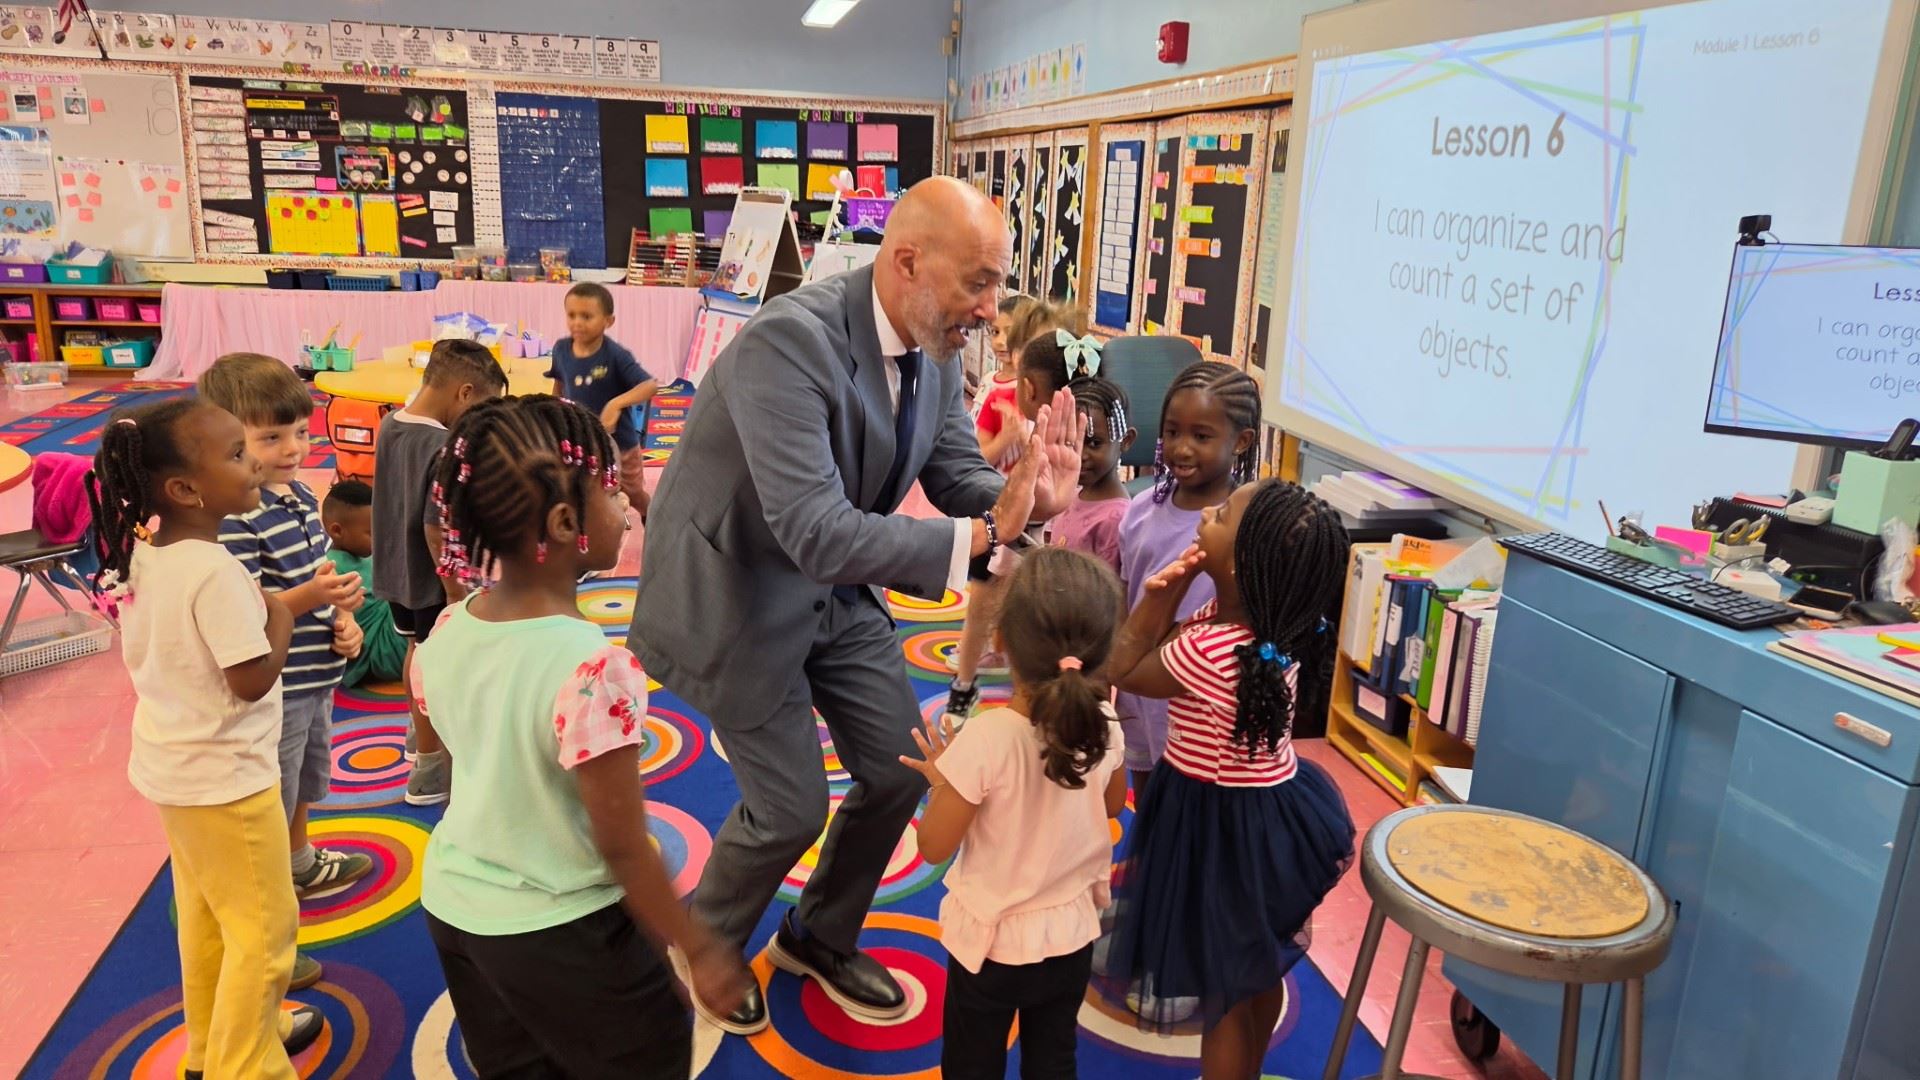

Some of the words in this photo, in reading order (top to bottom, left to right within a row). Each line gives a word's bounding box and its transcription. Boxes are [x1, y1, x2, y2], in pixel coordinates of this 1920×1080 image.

[137, 15, 149, 27] Ss
[182, 16, 195, 29] Uu
[206, 19, 221, 30] Vv
[228, 20, 248, 32] Ww
[256, 22, 269, 33] Xx
[280, 23, 294, 39] Yy
[305, 25, 318, 37] Zz
[343, 24, 352, 35] 0
[412, 28, 420, 40] 2
[446, 31, 455, 42] 3
[478, 33, 487, 45] 4
[511, 35, 519, 47] 5
[541, 37, 550, 48] 6
[573, 39, 580, 50] 7
[1692, 36, 1740, 55] Module
[1753, 31, 1804, 50] Lesson
[1808, 27, 1820, 46] 6
[607, 41, 615, 52] 8
[639, 43, 648, 54] 9
[343, 61, 417, 78] Calendar
[665, 102, 741, 117] WRITER'S
[799, 109, 864, 122] CORNER
[1431, 117, 1530, 158] Lesson
[1546, 113, 1565, 158] 6
[1374, 199, 1380, 232] I
[1387, 206, 1424, 239] can
[1433, 210, 1548, 261] organize
[1561, 214, 1628, 263] and
[1390, 262, 1454, 299] count
[1462, 273, 1477, 305] a
[1487, 274, 1535, 315] set
[1545, 281, 1584, 324] of
[1817, 316, 1823, 334] I
[1831, 321, 1870, 337] can
[1418, 319, 1511, 379] objects.
[1836, 346, 1900, 364] count
